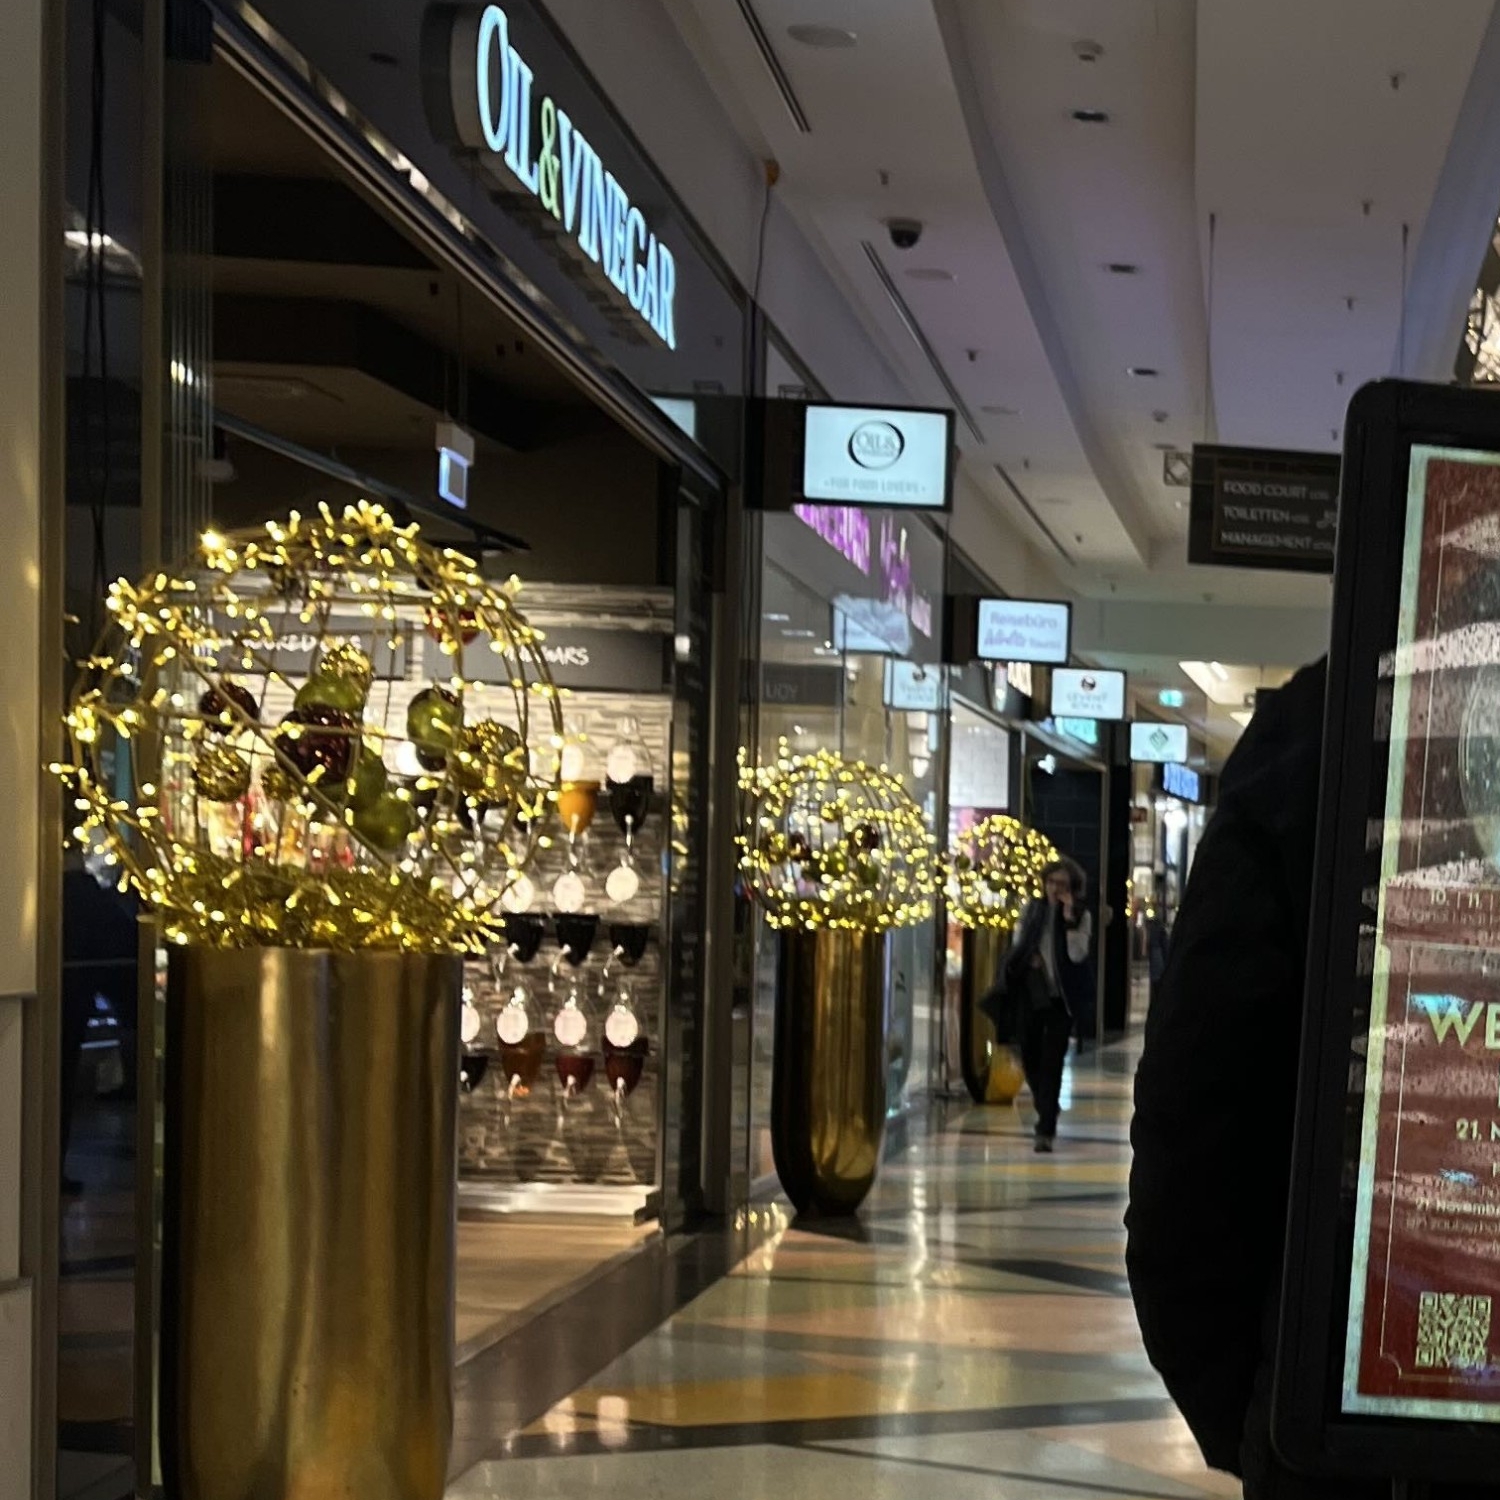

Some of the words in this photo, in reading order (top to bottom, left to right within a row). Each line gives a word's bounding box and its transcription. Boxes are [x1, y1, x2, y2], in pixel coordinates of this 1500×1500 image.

[1223, 480, 1261, 496] FOOD
[1263, 484, 1307, 499] COURT
[1223, 506, 1290, 522] TOILETTEN
[1221, 531, 1312, 549] MANAGEMENT
[1456, 1117, 1482, 1141] 21.
